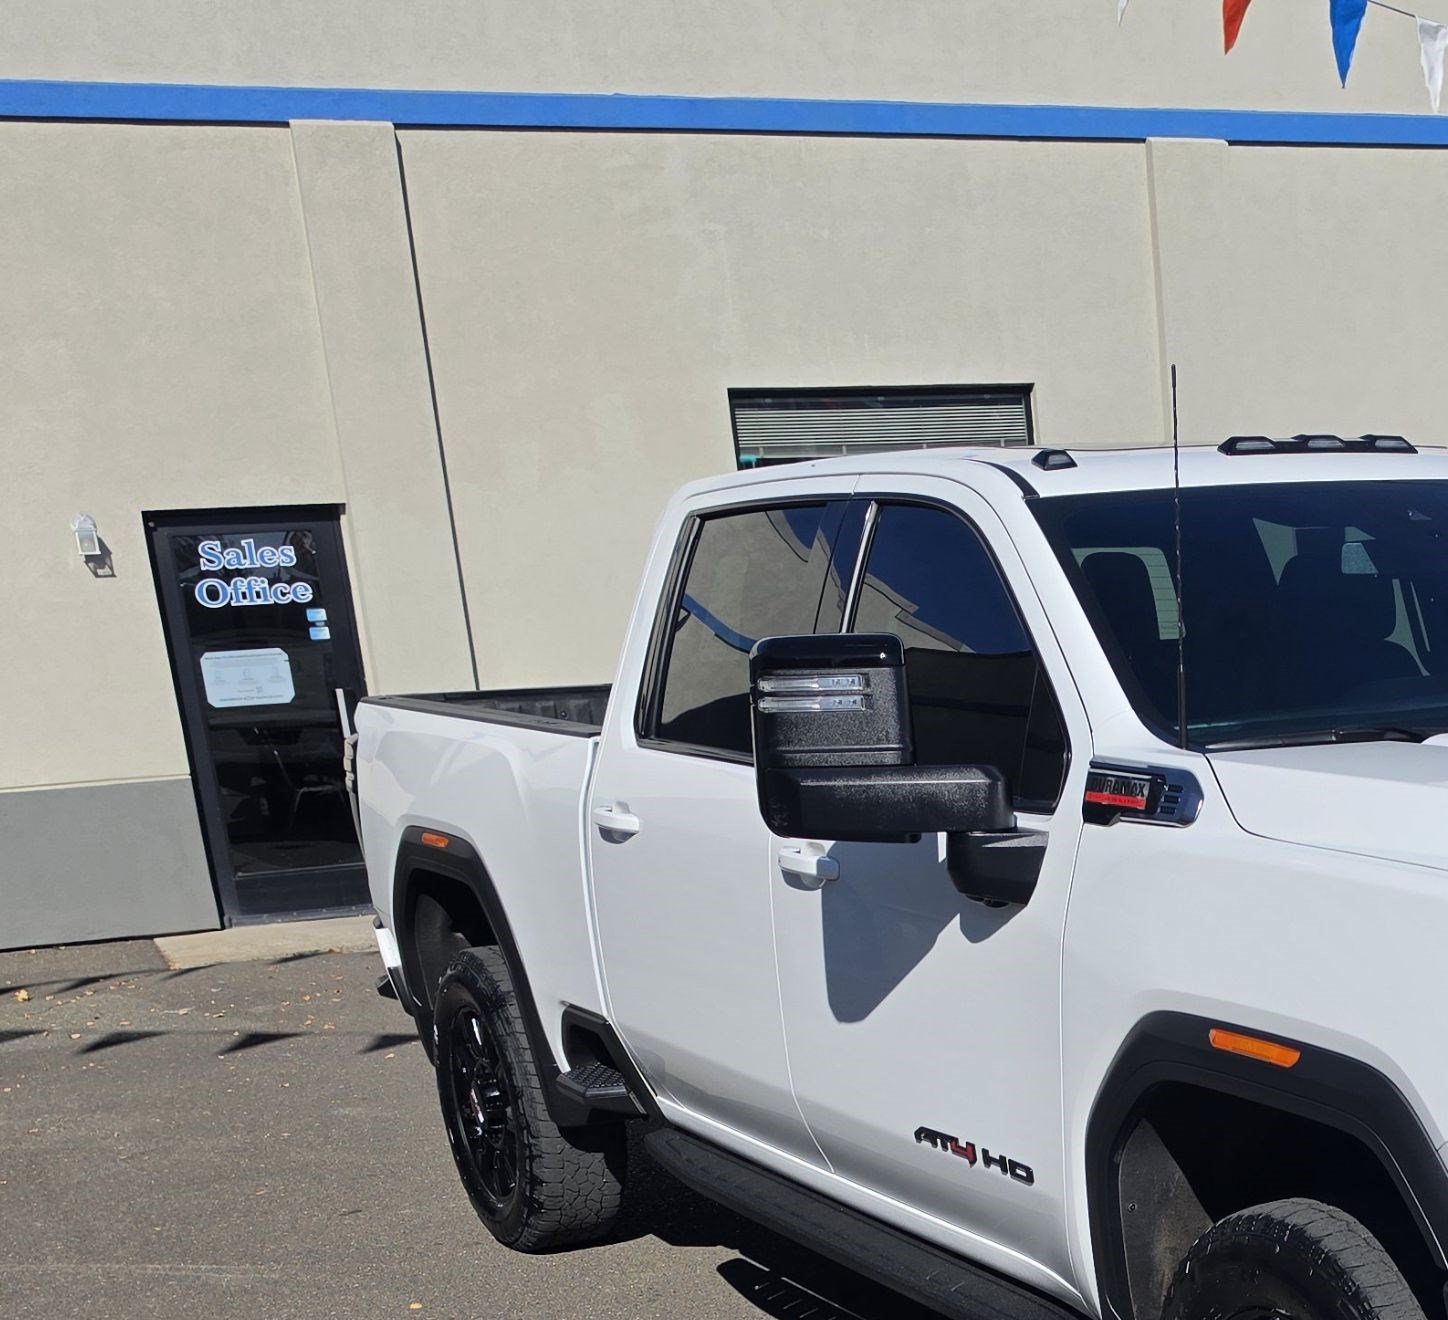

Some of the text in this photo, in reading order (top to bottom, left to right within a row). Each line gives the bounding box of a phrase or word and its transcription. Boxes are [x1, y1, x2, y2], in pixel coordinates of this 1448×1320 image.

[198, 538, 297, 571] Sales
[195, 576, 314, 608] Office
[914, 1126, 1035, 1186] AT4 HD
